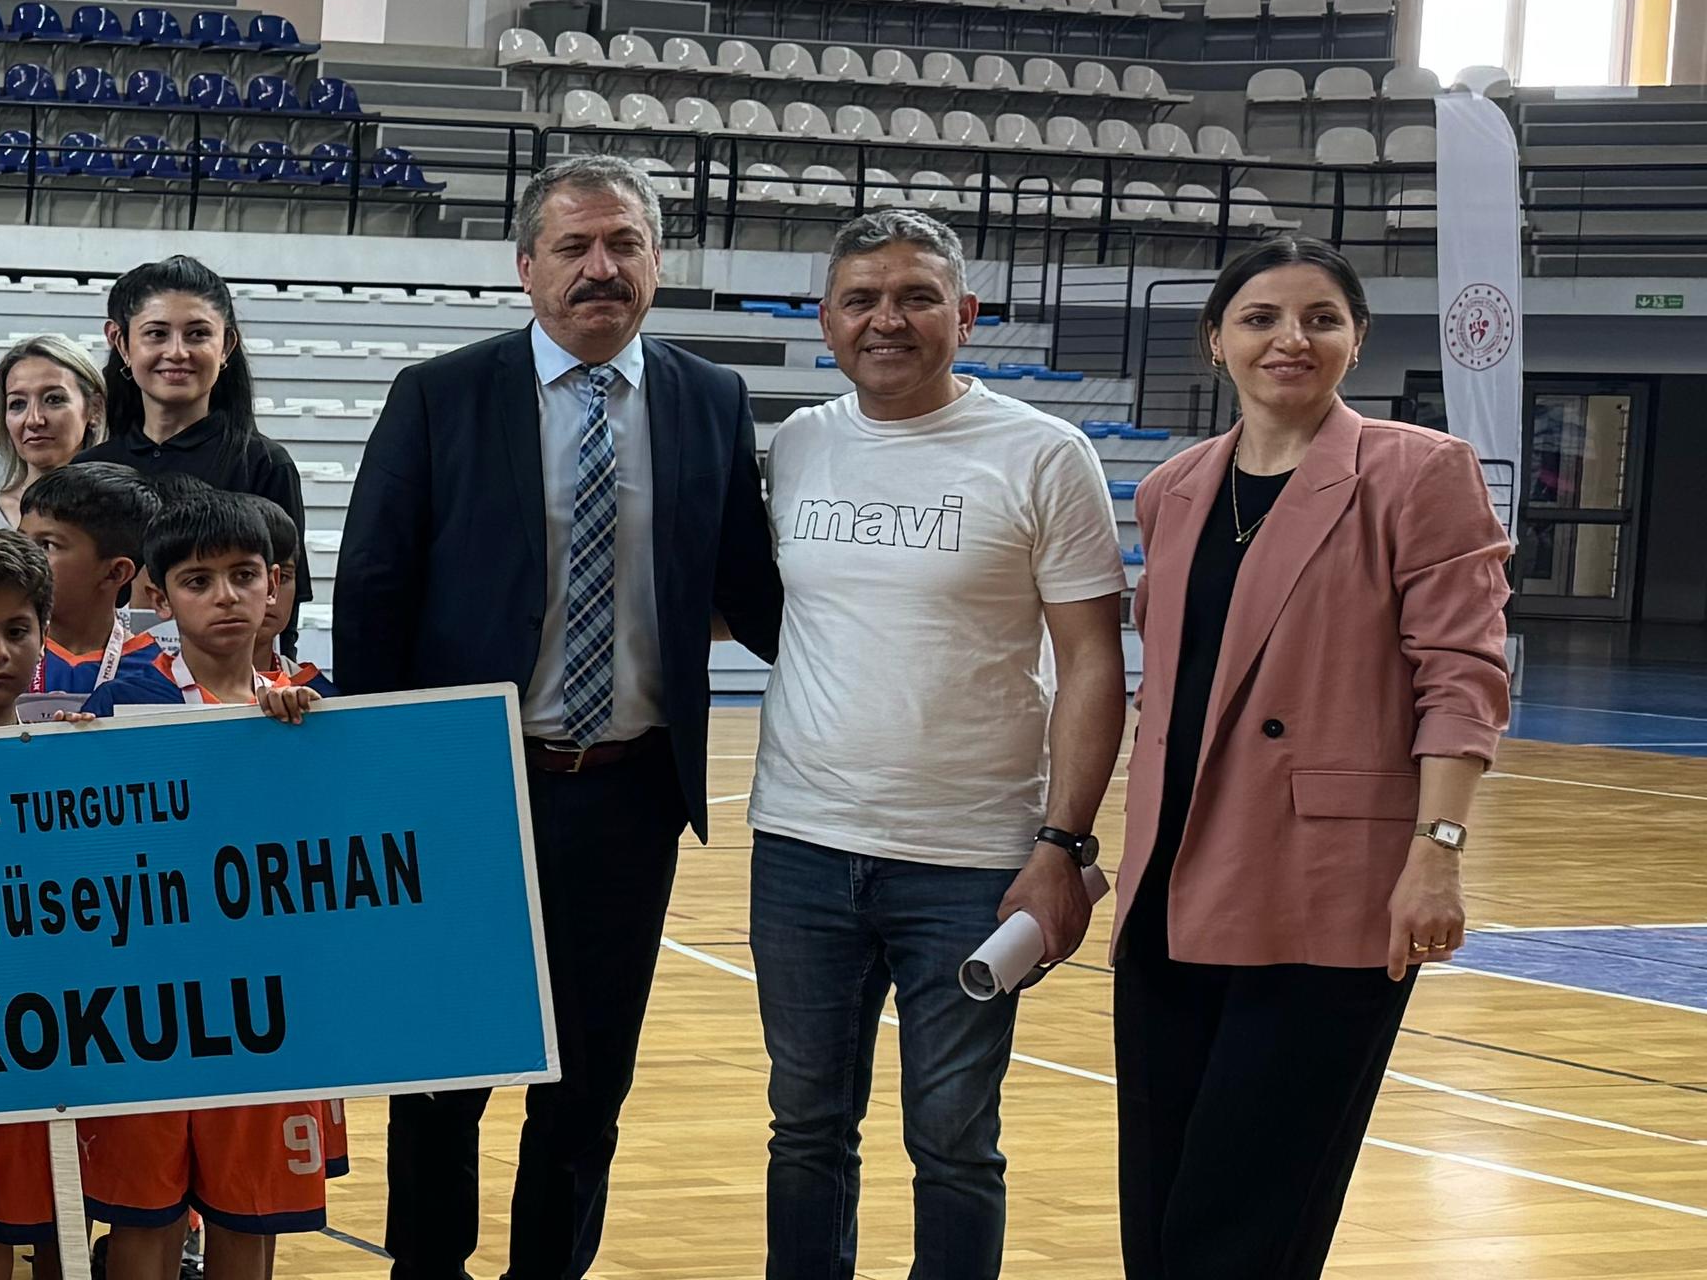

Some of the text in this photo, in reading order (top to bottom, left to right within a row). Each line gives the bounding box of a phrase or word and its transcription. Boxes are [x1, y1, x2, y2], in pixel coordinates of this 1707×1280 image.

[794, 495, 963, 552] mavi
[9, 778, 191, 832] TURGUTLU
[212, 830, 424, 919] ORHAN
[284, 1115, 322, 1175] 9
